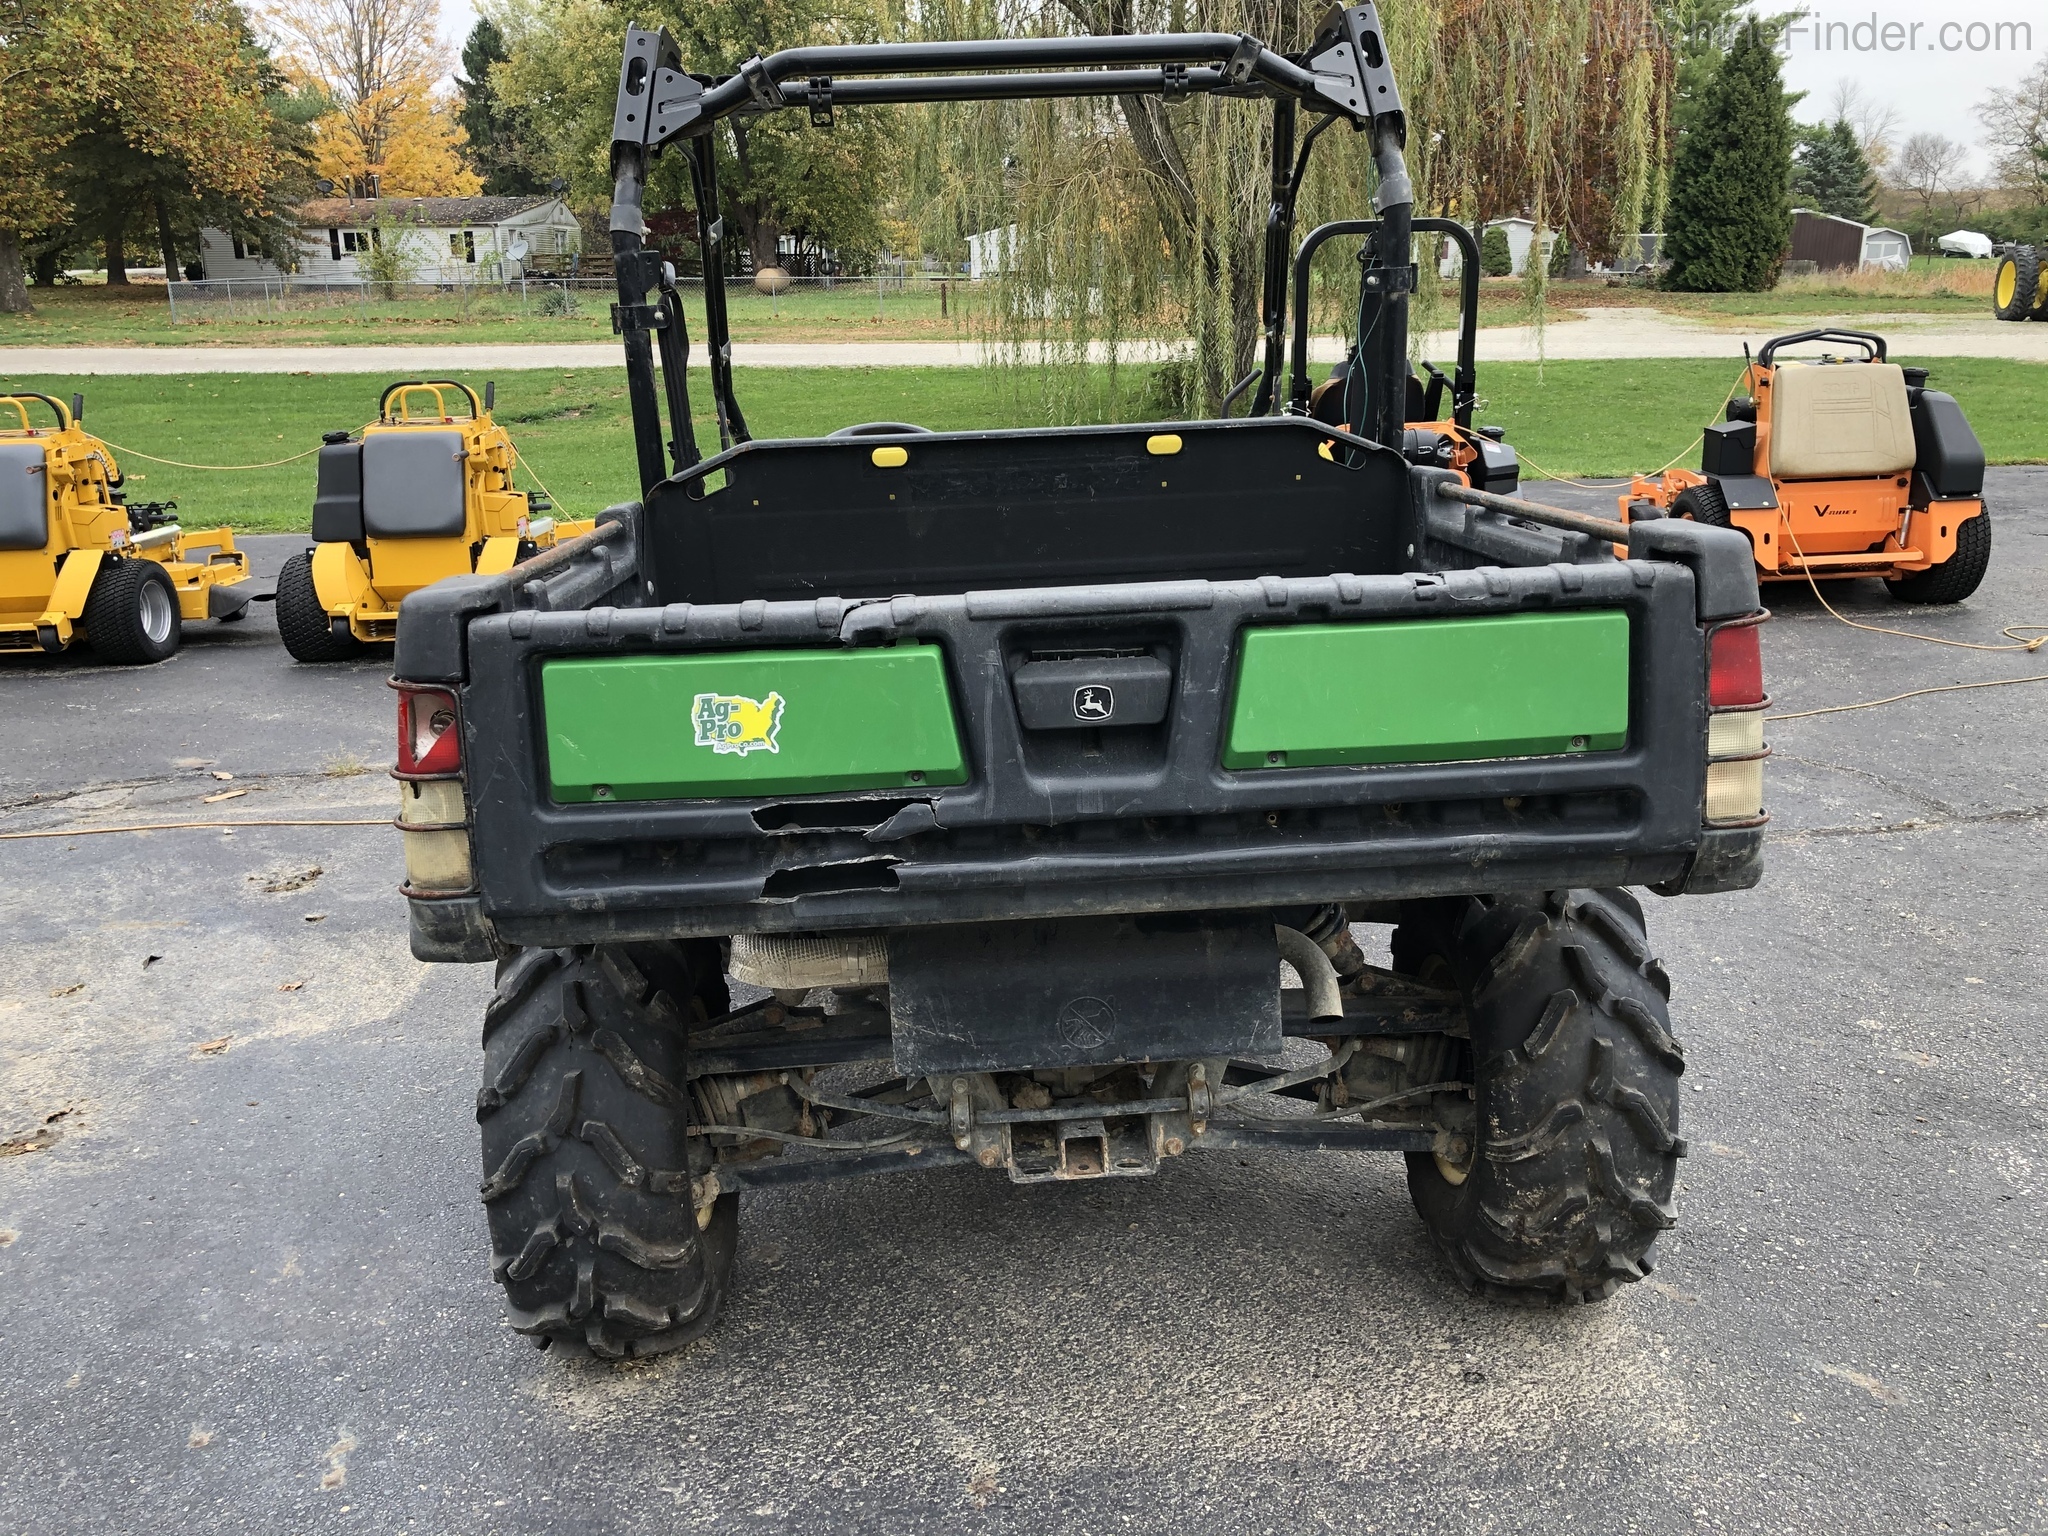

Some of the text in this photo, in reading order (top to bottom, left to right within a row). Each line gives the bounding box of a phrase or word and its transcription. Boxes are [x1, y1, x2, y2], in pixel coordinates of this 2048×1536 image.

[698, 697, 739, 722] Ag-
[700, 719, 742, 741] Pro
[716, 741, 766, 751] AgProCo.com
